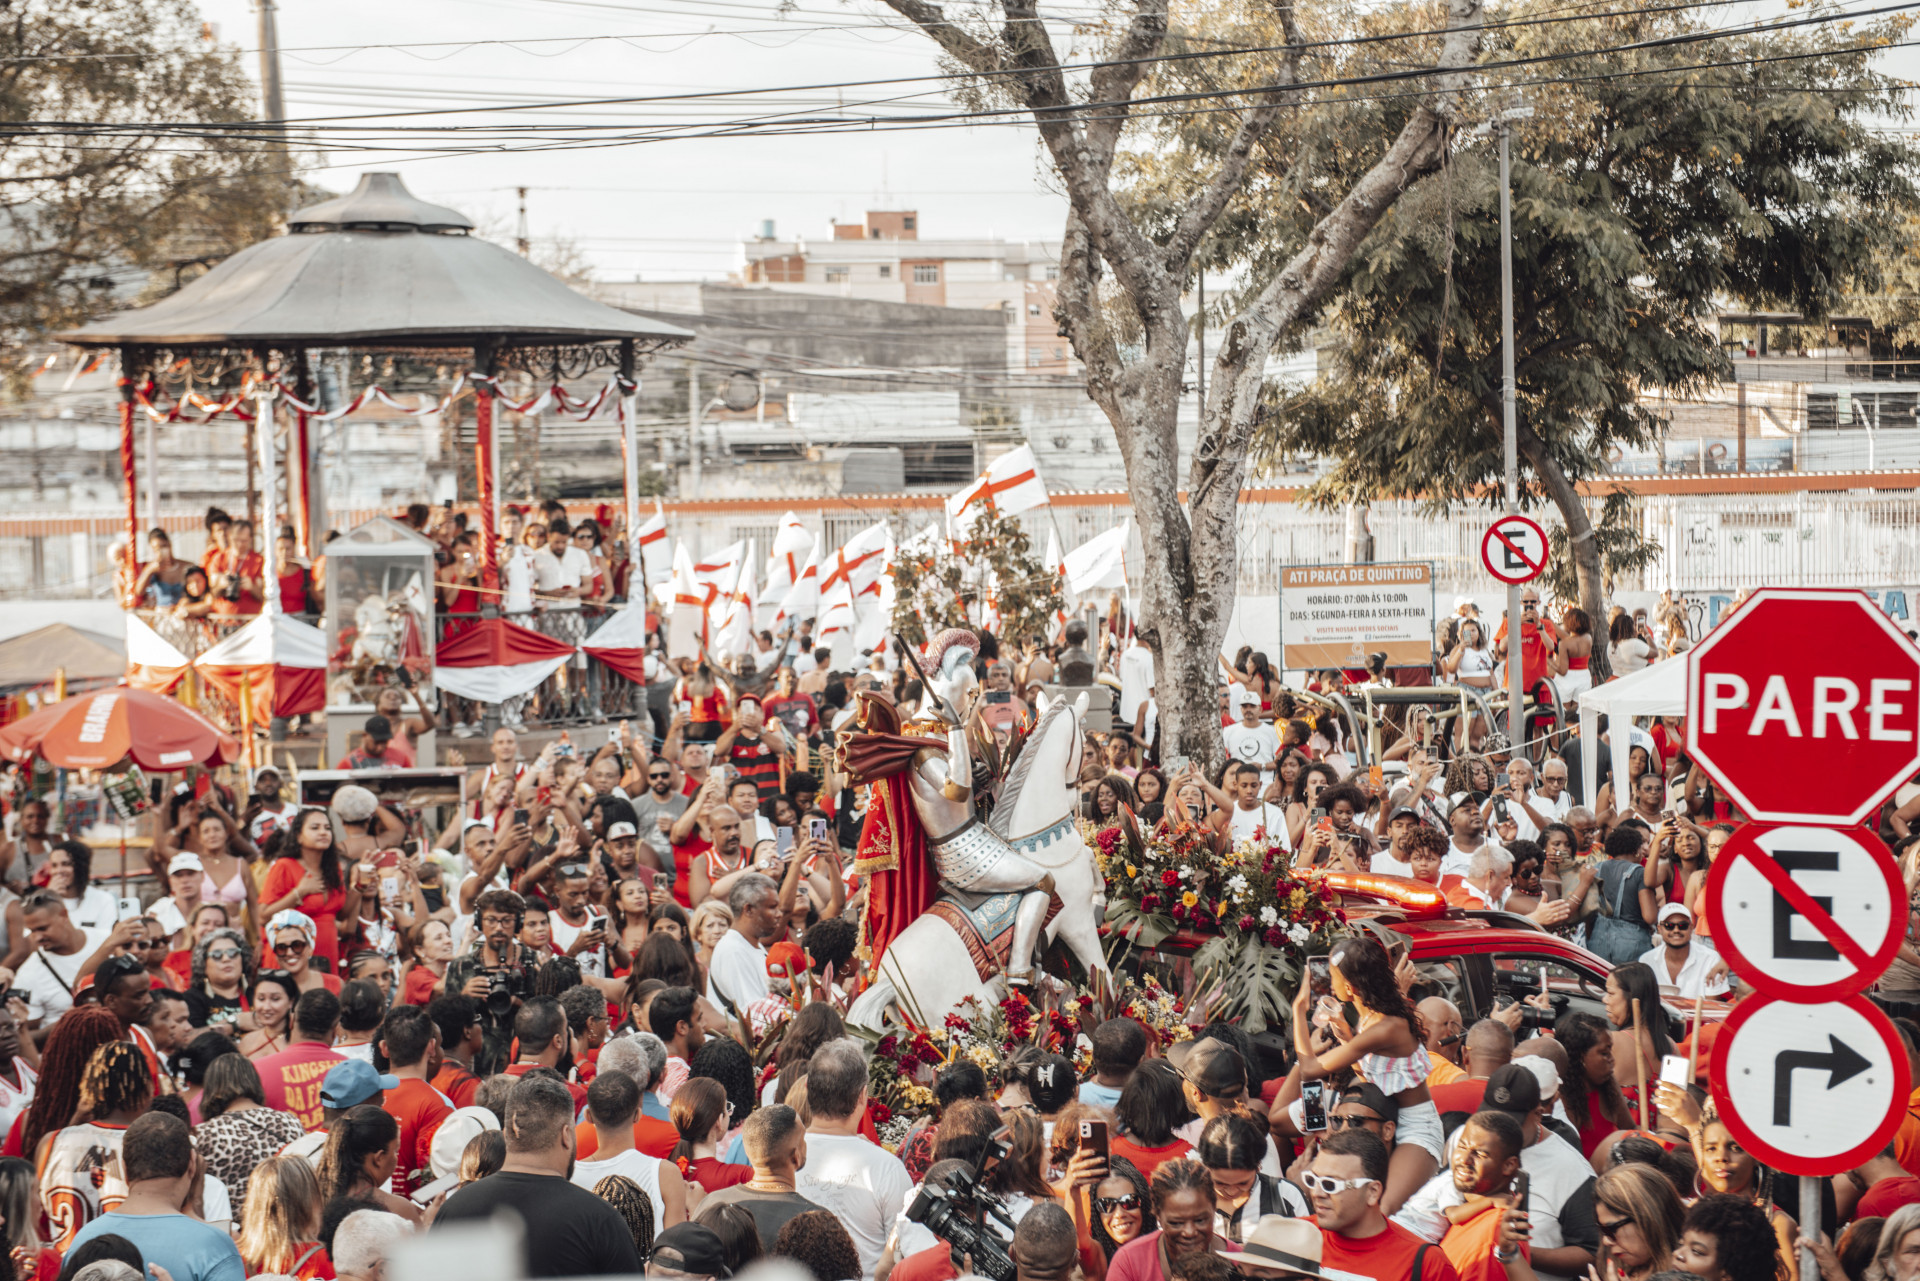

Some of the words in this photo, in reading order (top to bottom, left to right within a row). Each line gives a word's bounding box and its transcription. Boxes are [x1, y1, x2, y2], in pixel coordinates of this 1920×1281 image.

[1503, 531, 1527, 569] E
[1290, 570, 1308, 584] ATI
[1310, 569, 1347, 585] PRAÇA
[1349, 568, 1364, 582] DE
[1367, 567, 1423, 583] QUINTINO
[1307, 593, 1343, 605] HORÁRIO:
[1344, 592, 1370, 604] 07:00h
[1371, 591, 1381, 603] ÀS
[1383, 592, 1408, 603] 10:00h
[1290, 611, 1310, 621] DIAS:
[1311, 609, 1370, 620] SEGUNDA-FEIRA
[1371, 608, 1377, 618] A
[1378, 607, 1426, 618] SEXTA-FEIRA
[1702, 672, 1913, 742] PARE
[1773, 850, 1840, 961] E
